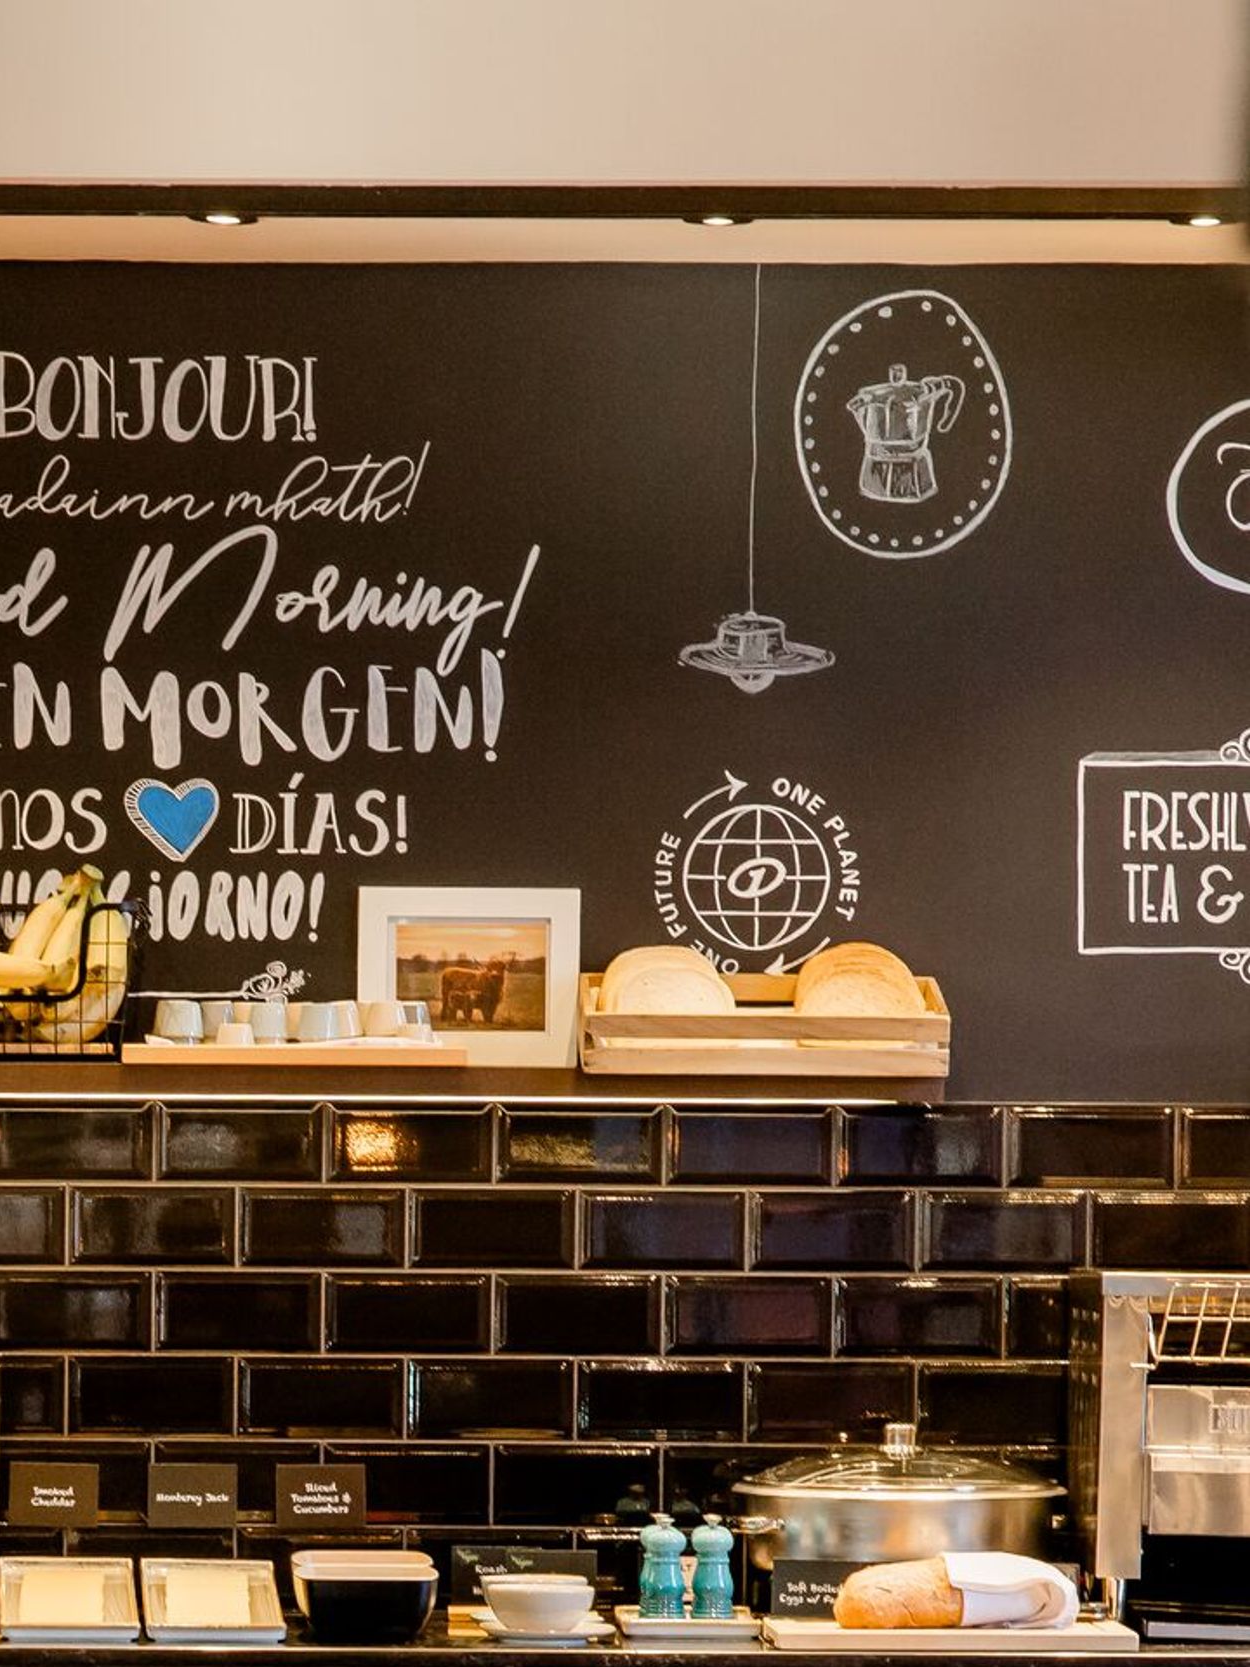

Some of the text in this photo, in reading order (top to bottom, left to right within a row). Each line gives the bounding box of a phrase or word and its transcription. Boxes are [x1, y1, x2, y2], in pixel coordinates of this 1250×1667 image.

[103, 525, 540, 677] Morning!
[101, 648, 504, 769] MORGEN!
[229, 772, 408, 856] DÍAS!
[771, 777, 861, 922] ONE PLANET
[654, 831, 688, 939] FUTURE
[1122, 863, 1245, 925] TEA &
[293, 1503, 350, 1514] Cucumbers
[305, 1482, 338, 1493] Sliced
